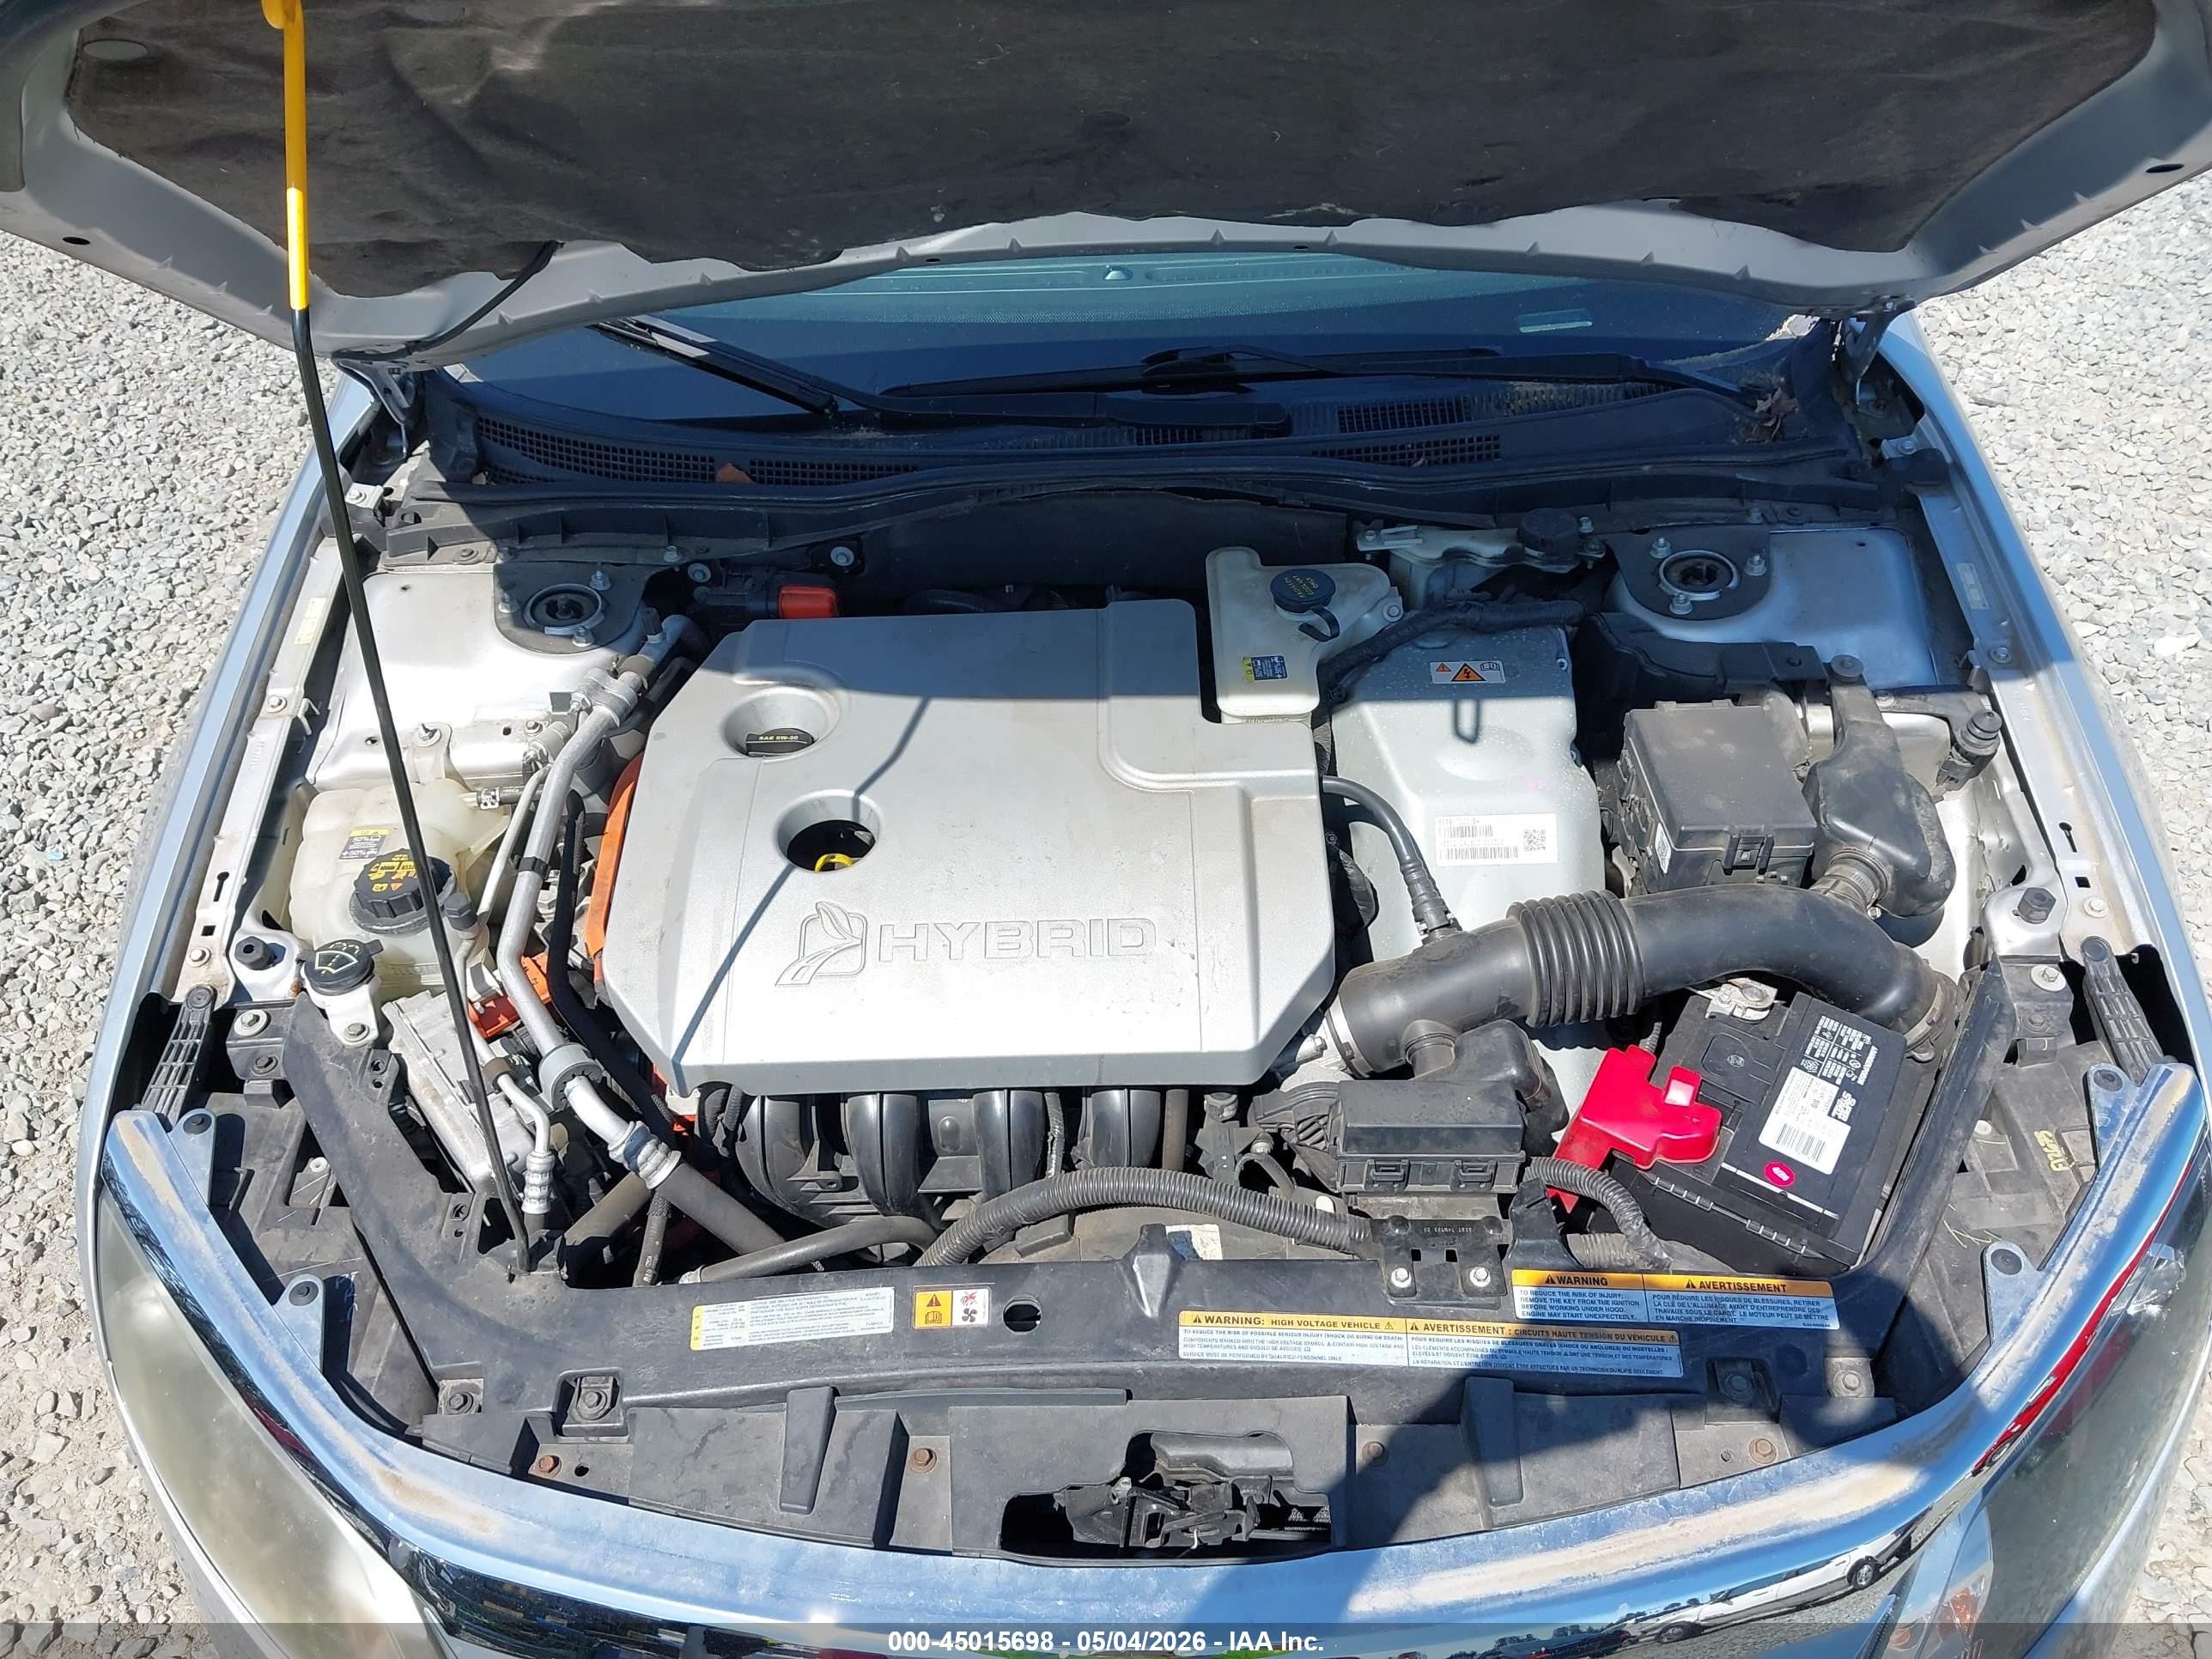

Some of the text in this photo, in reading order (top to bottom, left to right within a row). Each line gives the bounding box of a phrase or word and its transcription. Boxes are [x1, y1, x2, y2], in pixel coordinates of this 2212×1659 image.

[879, 917, 1158, 963] HYBRID
[1557, 1276, 1607, 1285] WARNING
[1699, 1280, 1786, 1292] AVERTISSEMENT
[1205, 1316, 1264, 1325] WARNING:
[1424, 1323, 1505, 1334] AVERTISSEMENT
[1515, 1329, 1550, 1338] CIRCUITS
